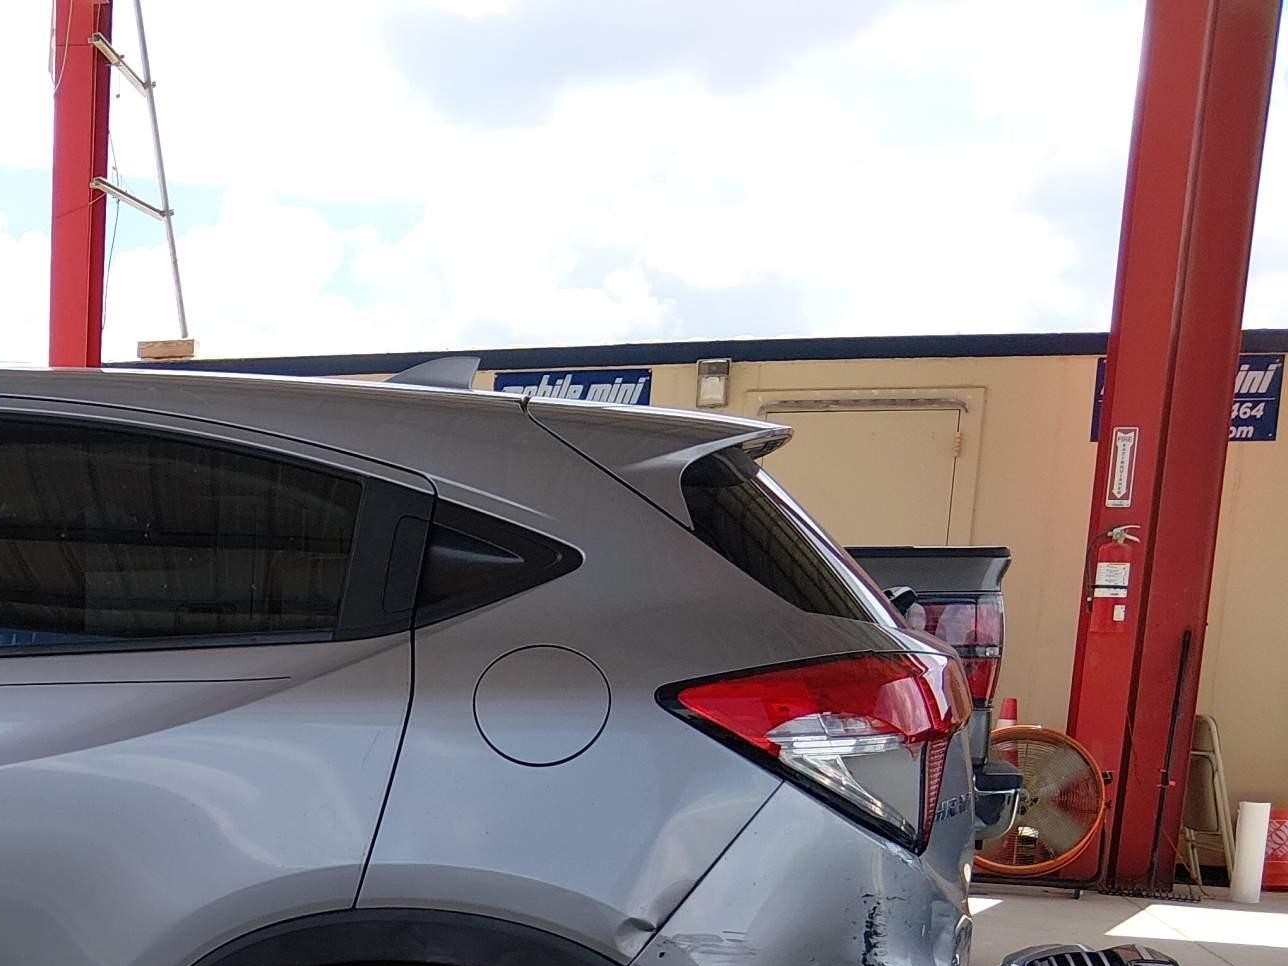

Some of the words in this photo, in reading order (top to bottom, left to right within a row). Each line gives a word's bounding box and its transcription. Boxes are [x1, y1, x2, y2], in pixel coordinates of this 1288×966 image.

[502, 374, 584, 399] obile
[585, 377, 645, 404] mini
[1234, 364, 1278, 394] ini
